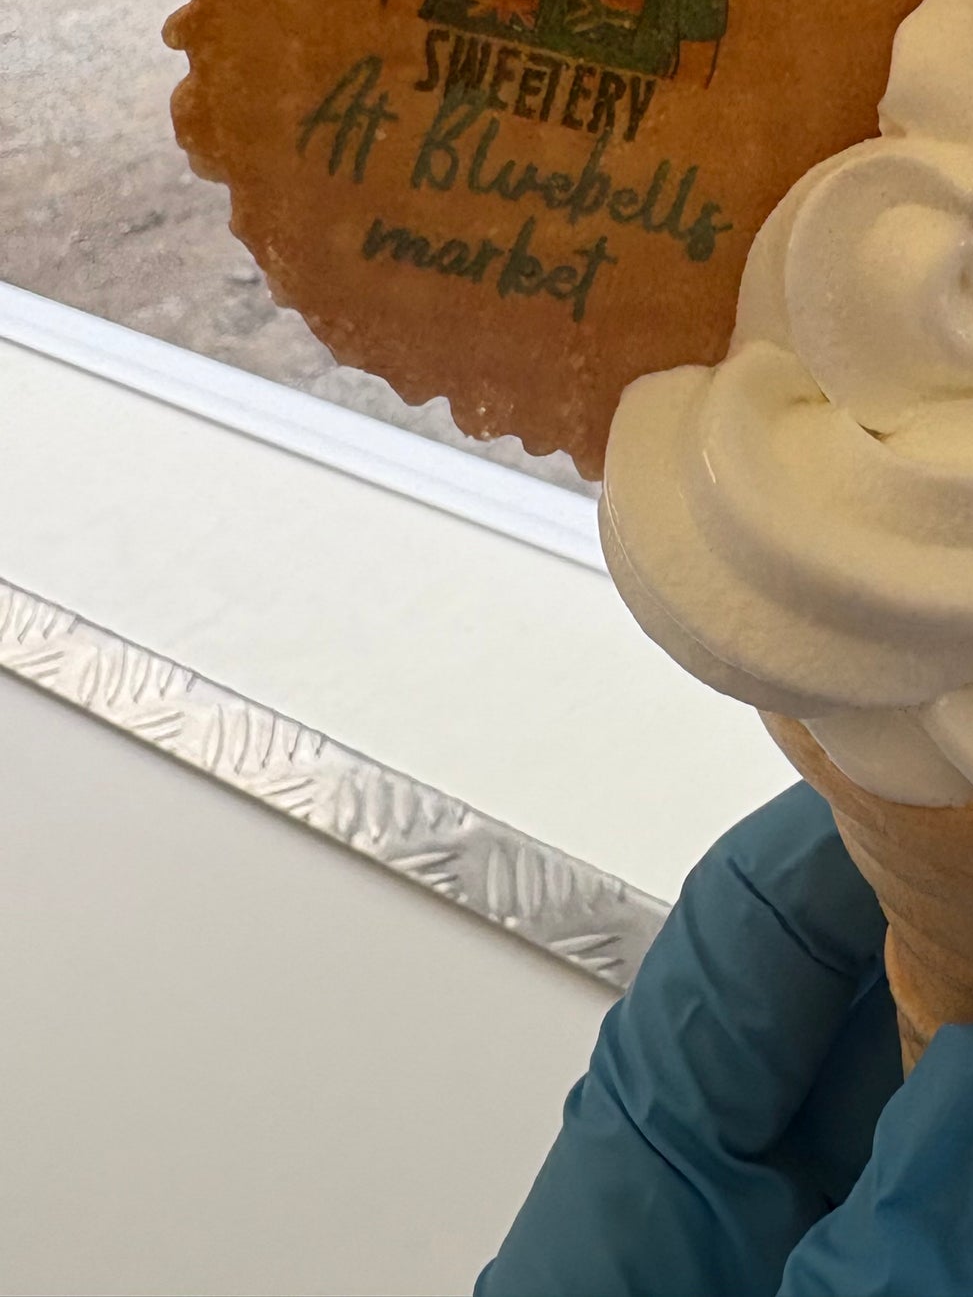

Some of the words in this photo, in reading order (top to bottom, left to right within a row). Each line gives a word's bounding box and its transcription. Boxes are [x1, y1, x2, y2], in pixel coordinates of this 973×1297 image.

[414, 28, 658, 142] SWEETERY
[296, 53, 399, 185] At
[409, 82, 734, 263] Bluebells
[361, 214, 618, 324] market
